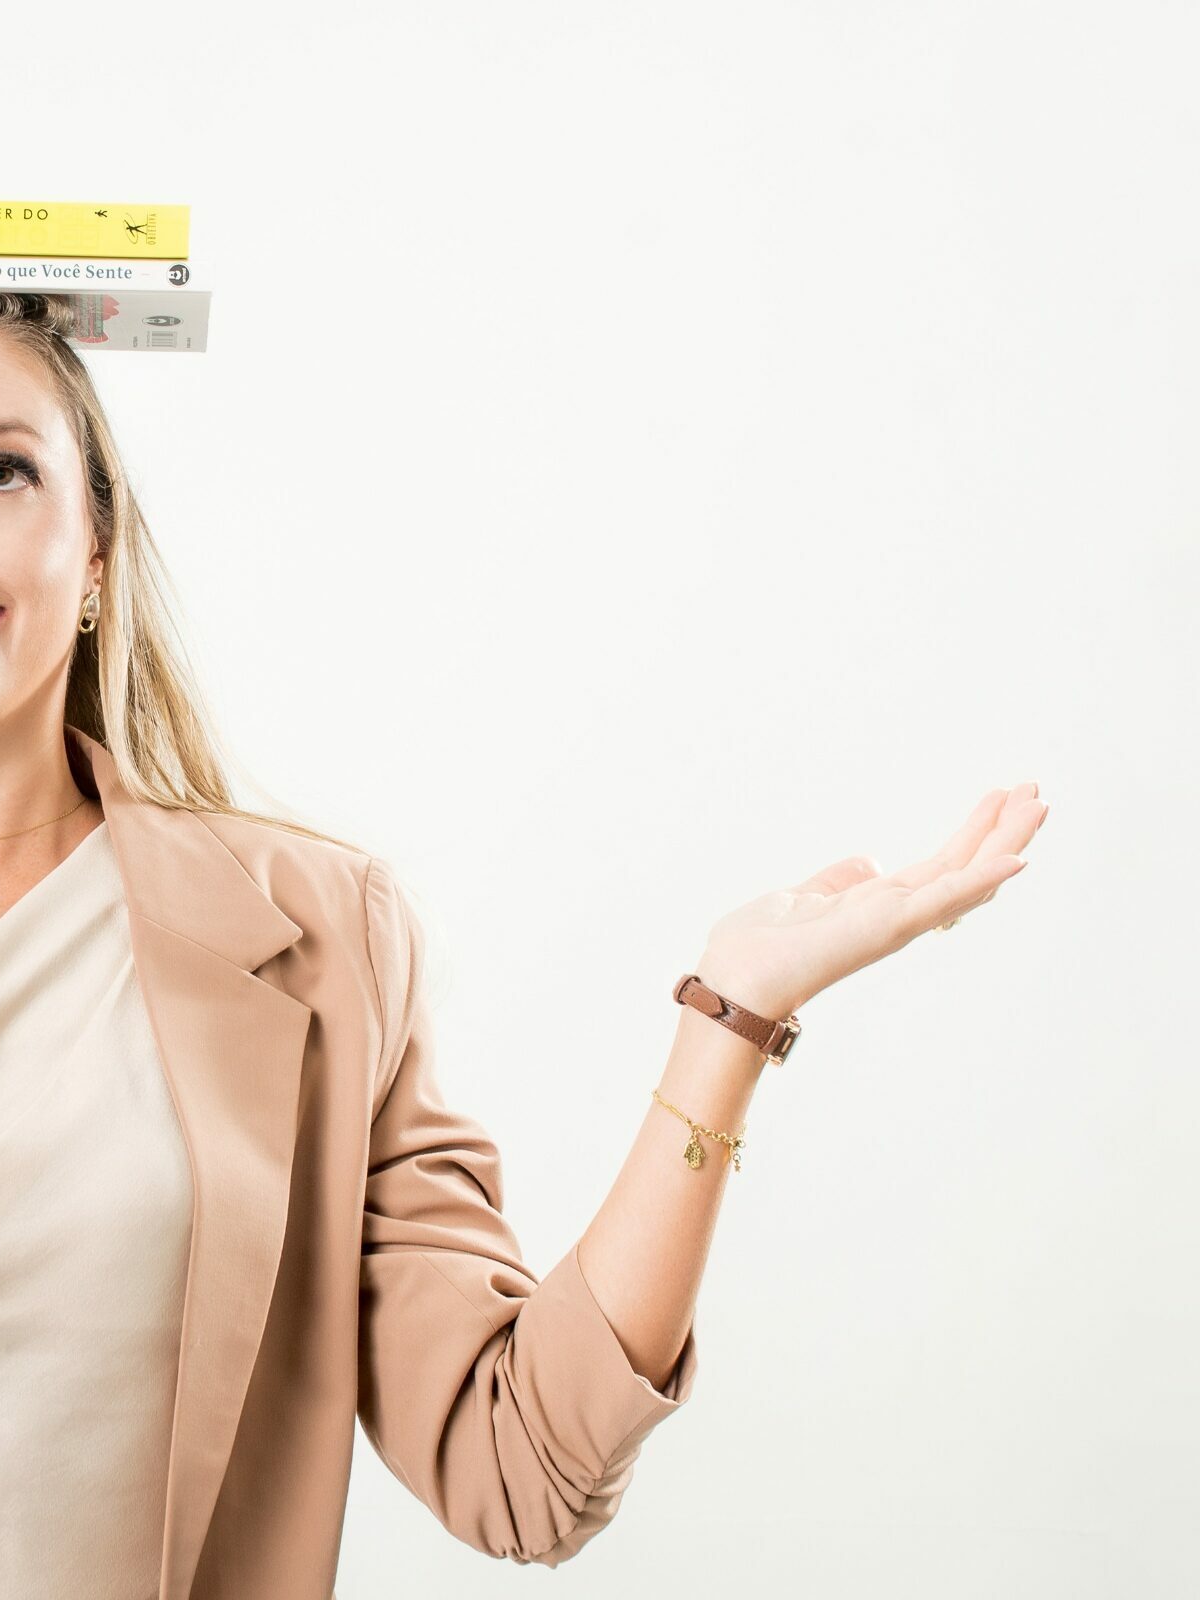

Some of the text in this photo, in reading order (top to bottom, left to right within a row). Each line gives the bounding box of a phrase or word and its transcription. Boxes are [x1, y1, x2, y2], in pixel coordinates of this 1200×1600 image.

[23, 208, 48, 220] DO
[7, 265, 37, 281] que
[41, 264, 81, 279] Você
[85, 265, 133, 279] Sente
